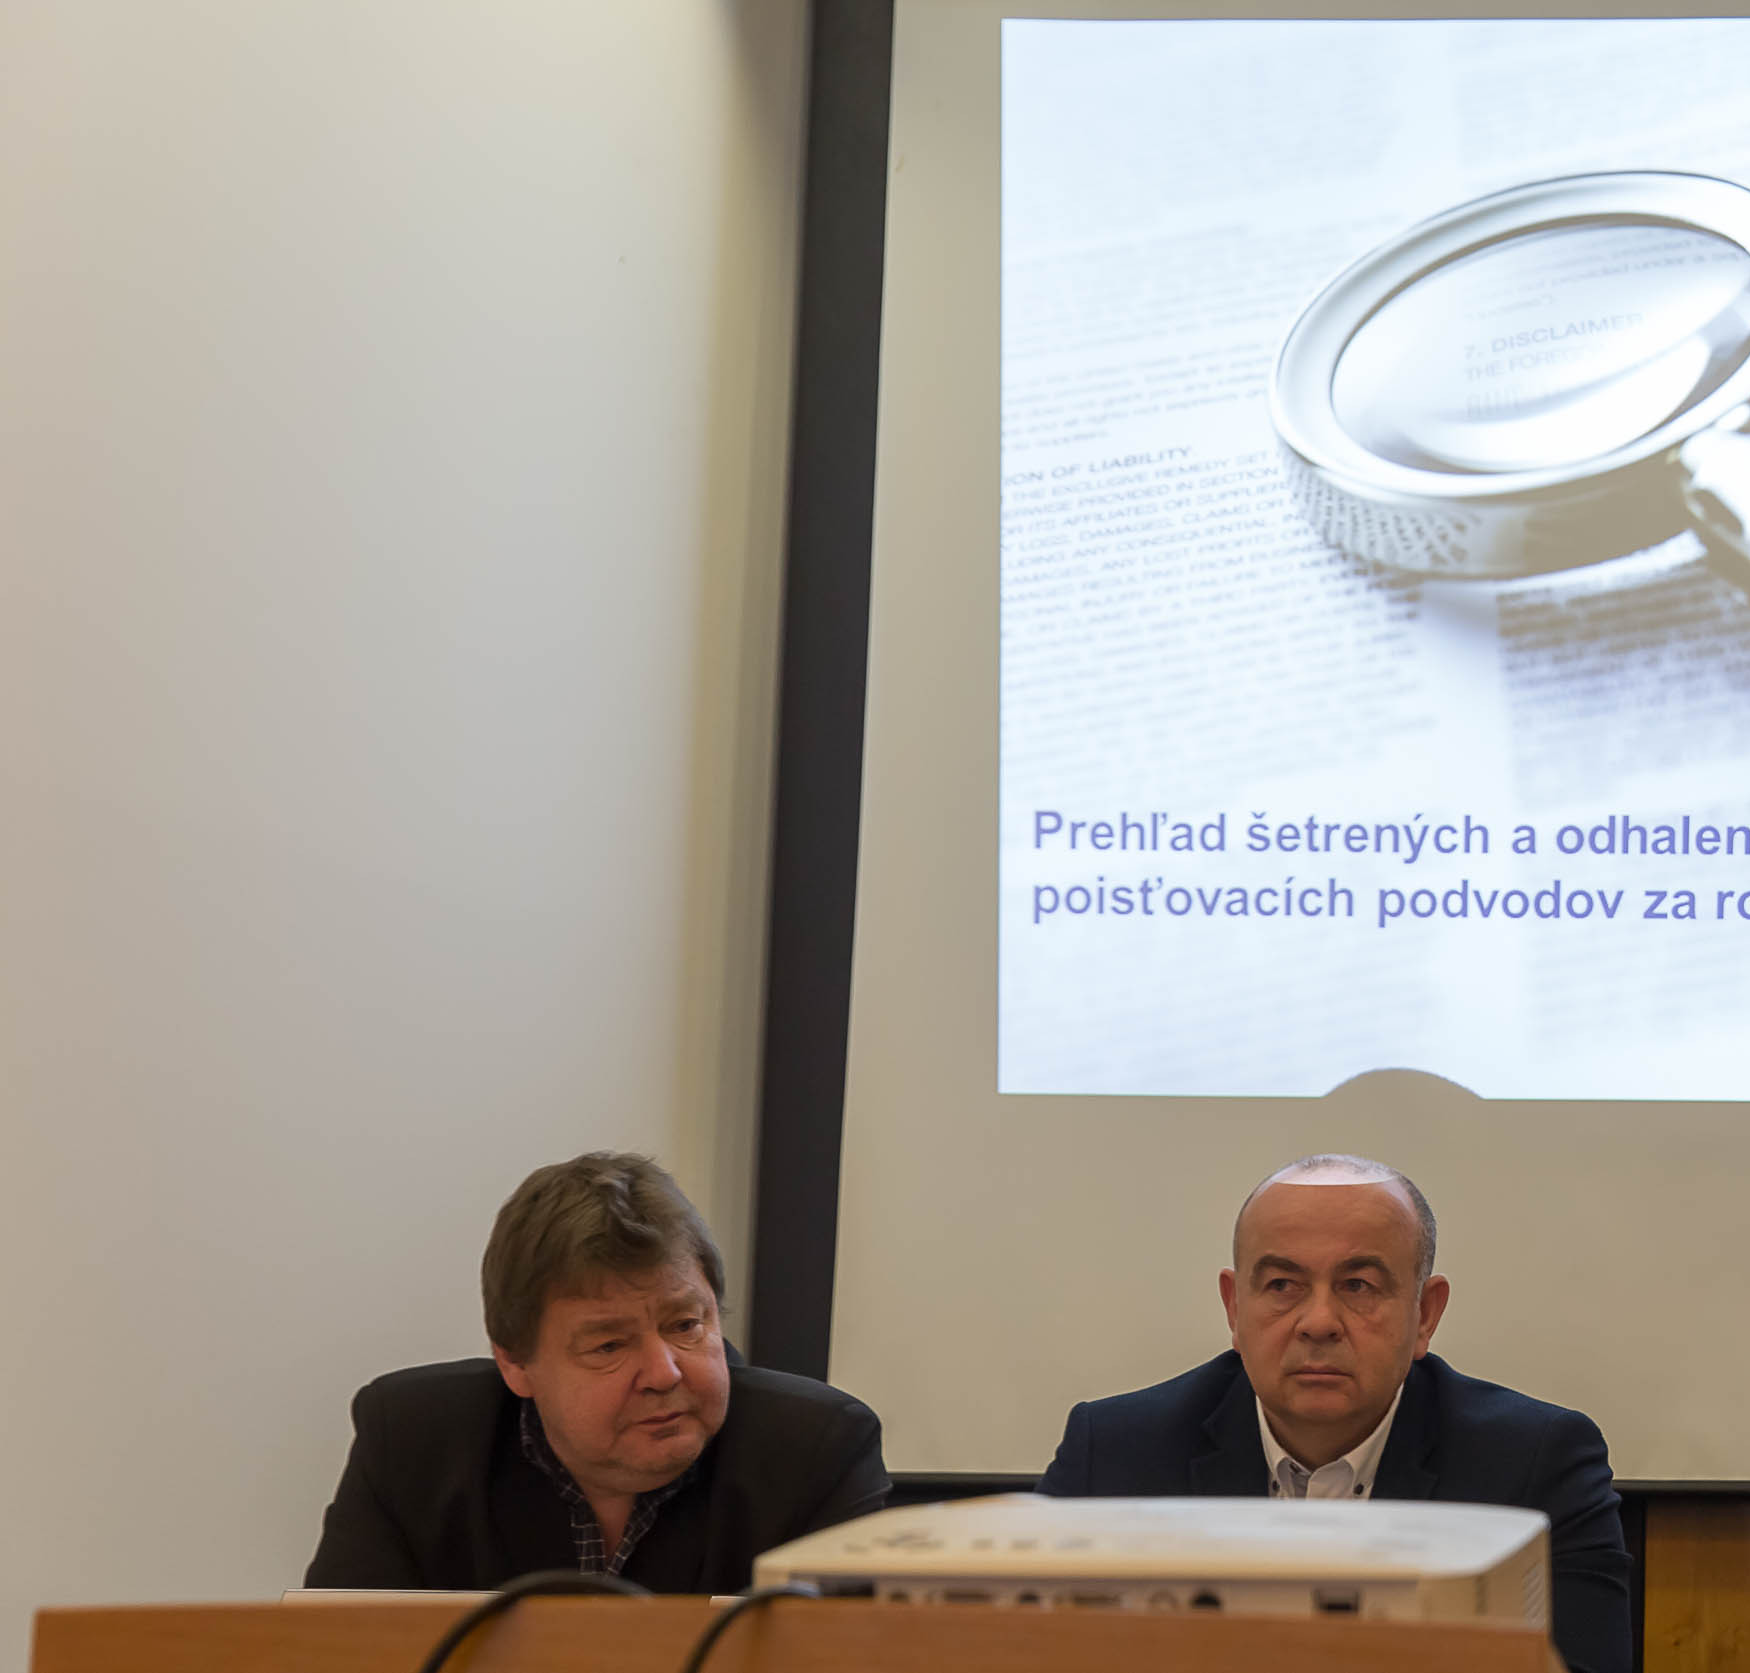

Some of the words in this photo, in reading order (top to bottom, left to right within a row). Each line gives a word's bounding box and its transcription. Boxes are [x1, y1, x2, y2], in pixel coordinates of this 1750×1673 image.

[1491, 313, 1642, 352] DISCLAIMER
[1051, 464, 1080, 478] OF
[1034, 811, 1228, 853] Prehľad
[1246, 812, 1490, 866] šetrených
[1511, 824, 1537, 855] a
[1032, 874, 1355, 926] poisťovacích
[1377, 879, 1626, 930] podvodov
[1642, 889, 1698, 920] za
